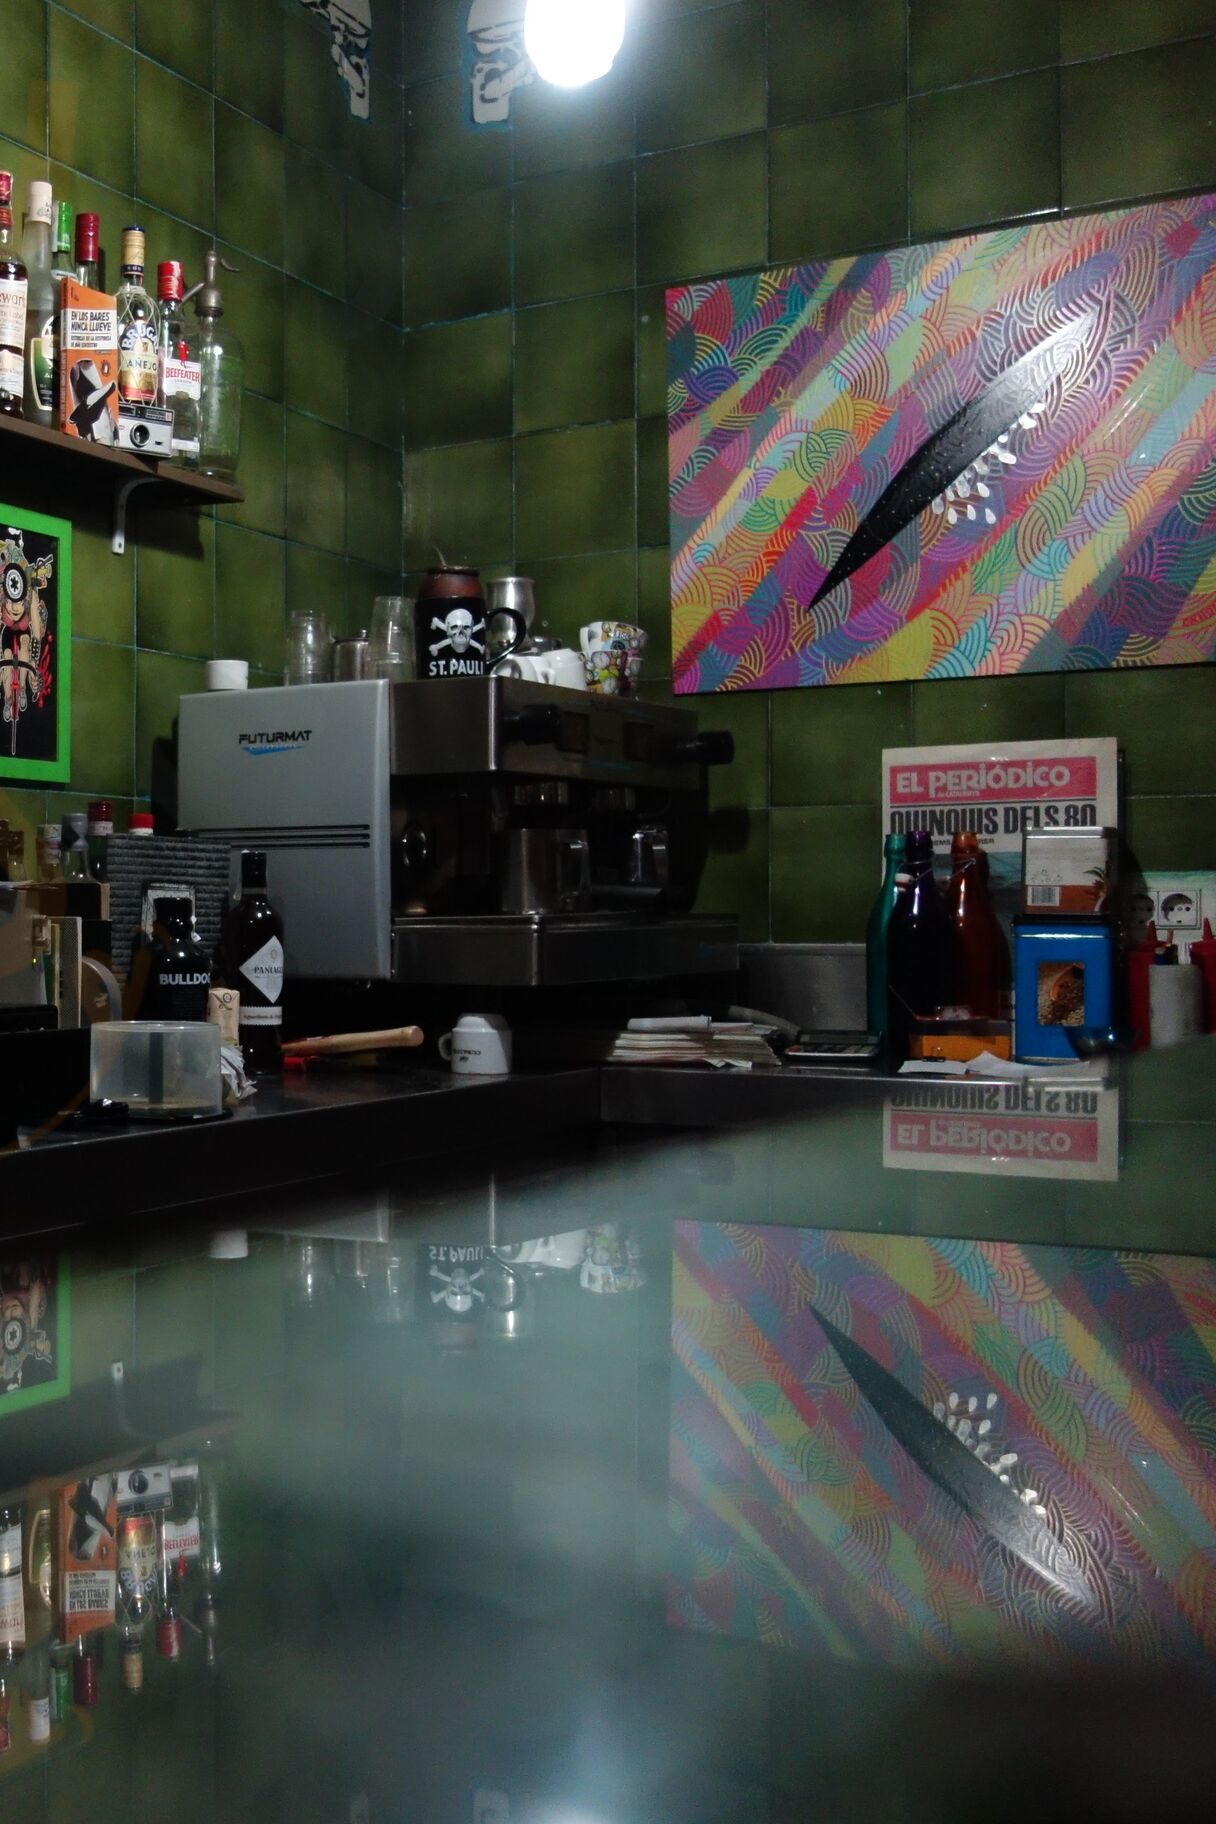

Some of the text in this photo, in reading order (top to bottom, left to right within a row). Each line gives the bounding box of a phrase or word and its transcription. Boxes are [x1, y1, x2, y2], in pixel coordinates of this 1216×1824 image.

[90, 312, 110, 321] BARES
[71, 322, 112, 331] NUNCA LLUEVE
[165, 366, 201, 383] BEEFEATER
[449, 658, 484, 676] PAULI
[239, 730, 313, 745] FUTURMAT
[896, 771, 925, 793] EL
